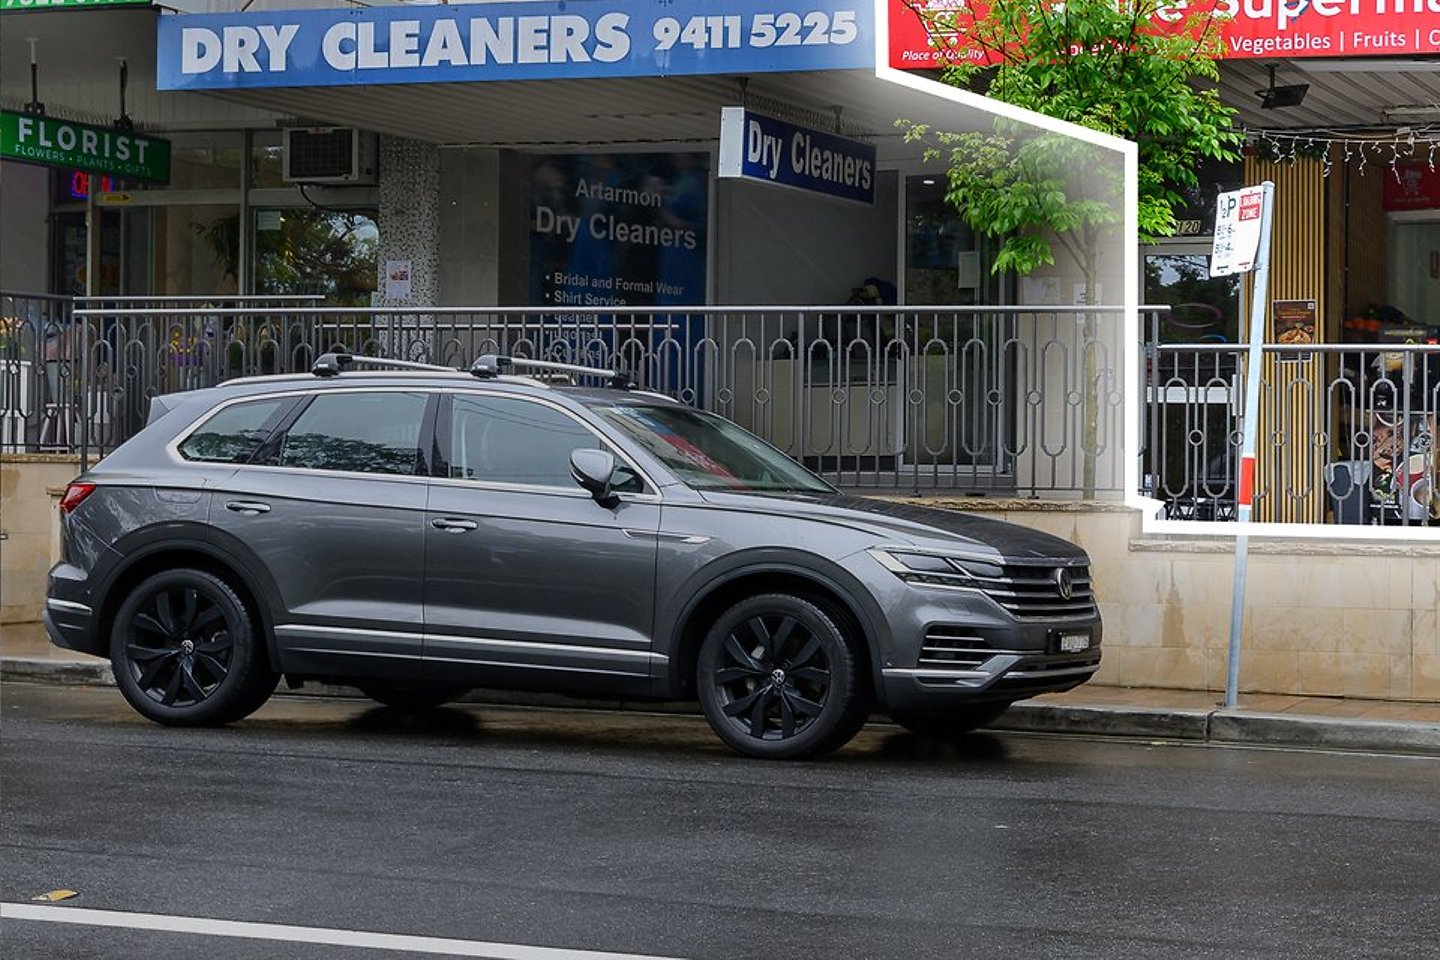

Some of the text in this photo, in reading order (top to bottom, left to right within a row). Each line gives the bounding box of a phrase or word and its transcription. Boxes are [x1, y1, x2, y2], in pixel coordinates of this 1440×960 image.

[181, 10, 858, 74] DRY CLEANERS 9411 5225
[902, 49, 930, 60] Place
[1230, 32, 1331, 53] Vegetables
[1353, 30, 1406, 48] Fruits
[18, 117, 149, 164] FLORIST
[747, 119, 871, 190] Dry Cleaners
[15, 144, 65, 161] FLOWERS
[77, 155, 115, 171] PLANTS
[575, 178, 662, 208] Artarmon
[535, 205, 698, 250] Dry Cleaners
[554, 272, 685, 296] Bridal and Formal Wear
[554, 290, 627, 307] Shirt Service
